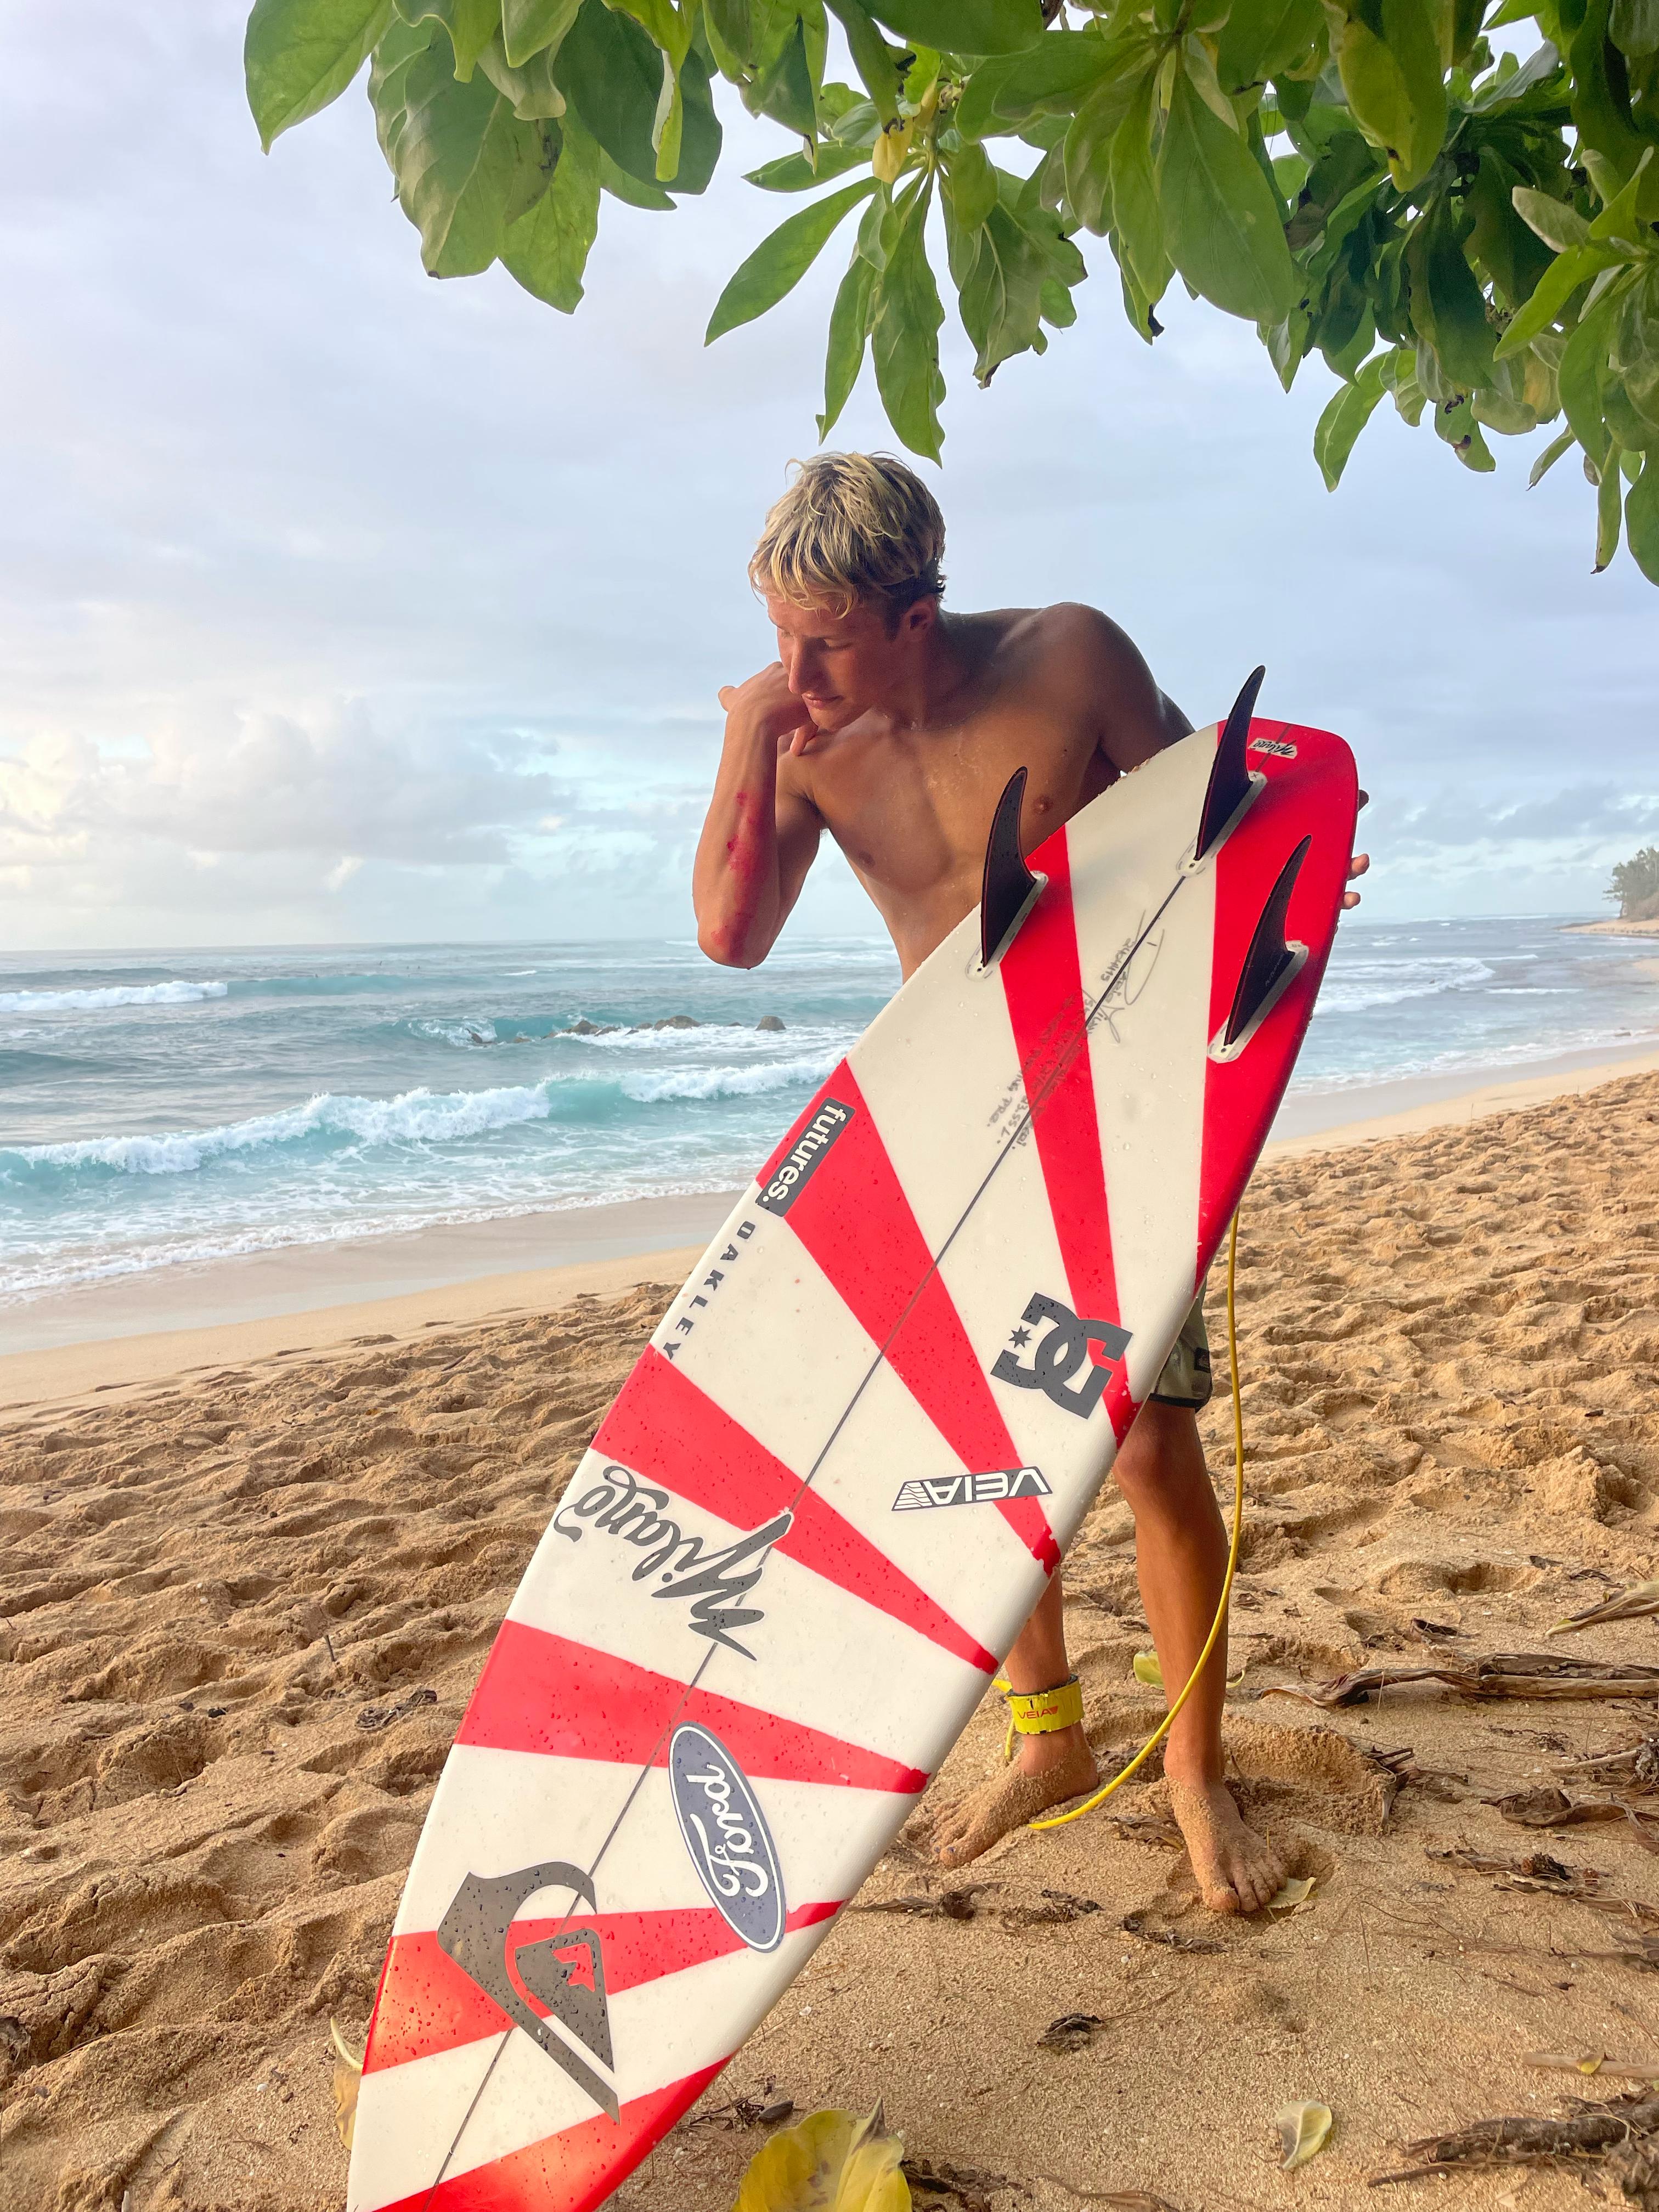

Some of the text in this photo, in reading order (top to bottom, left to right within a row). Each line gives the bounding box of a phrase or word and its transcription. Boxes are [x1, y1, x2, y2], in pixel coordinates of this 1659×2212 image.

[763, 1105, 847, 1202] futures.
[663, 1221, 755, 1360] OAKLEY
[990, 1292, 1133, 1419] DC
[923, 1468, 1049, 1505] VEIA
[554, 1466, 792, 1661] Milano
[1018, 1708, 1052, 1719] VEIA
[686, 1764, 768, 1897] Ford
